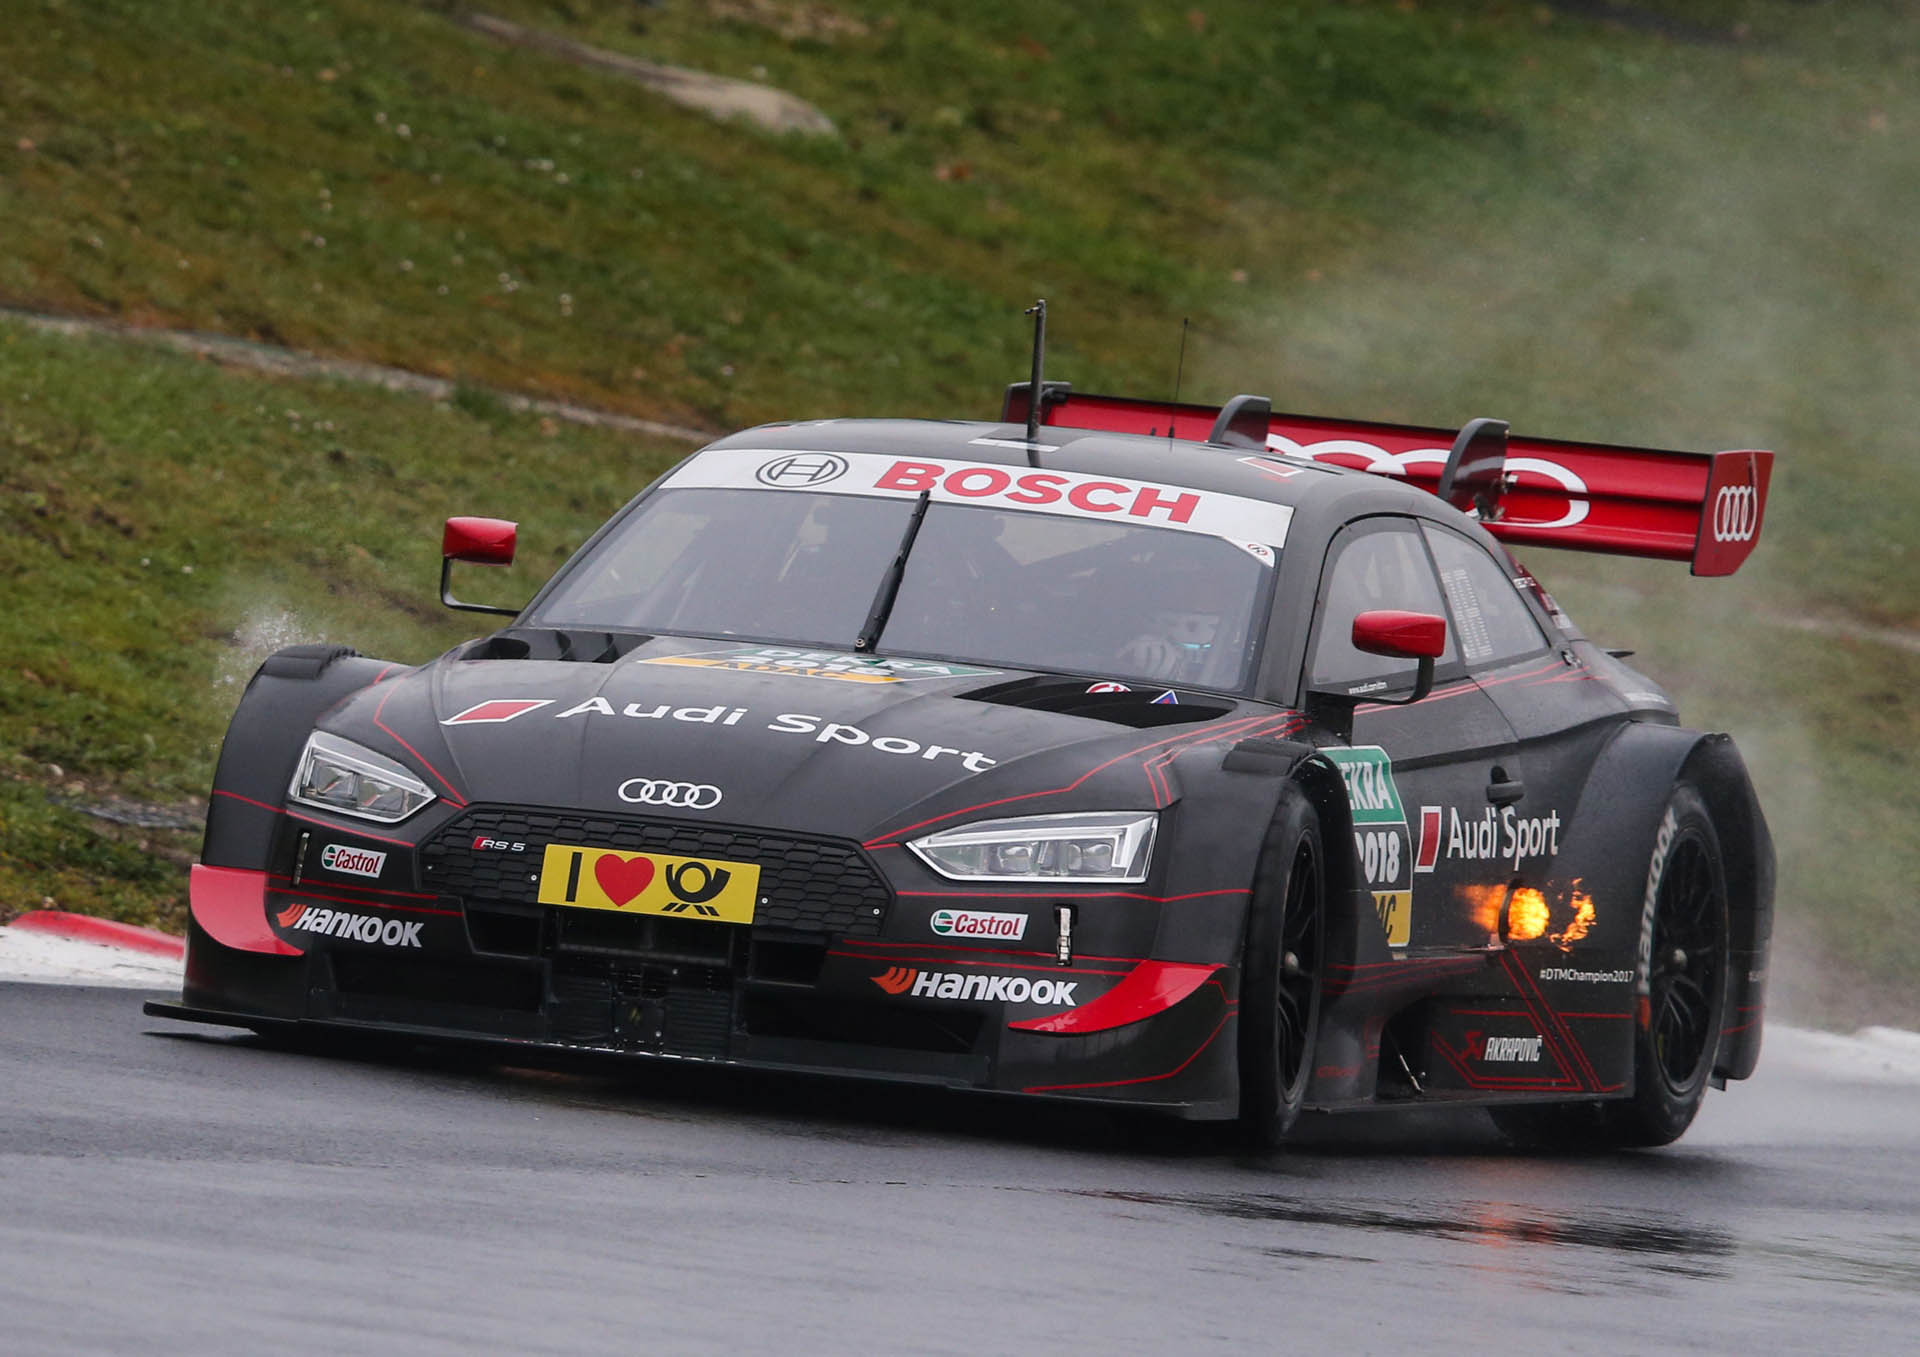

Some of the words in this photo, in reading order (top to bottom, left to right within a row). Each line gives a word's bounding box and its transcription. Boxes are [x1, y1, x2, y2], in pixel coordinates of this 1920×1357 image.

[873, 460, 1201, 524] BOSCH
[554, 696, 748, 725] Audi
[767, 712, 998, 773] Sport
[1339, 760, 1395, 810] EKRA
[480, 838, 509, 851] RS
[511, 842, 526, 852] 5
[1446, 806, 1498, 860] Audi
[1500, 805, 1561, 872] Sport
[335, 848, 381, 874] Castrol
[954, 913, 1021, 937] Castrol
[1539, 968, 1635, 984] #DTMChampion2017
